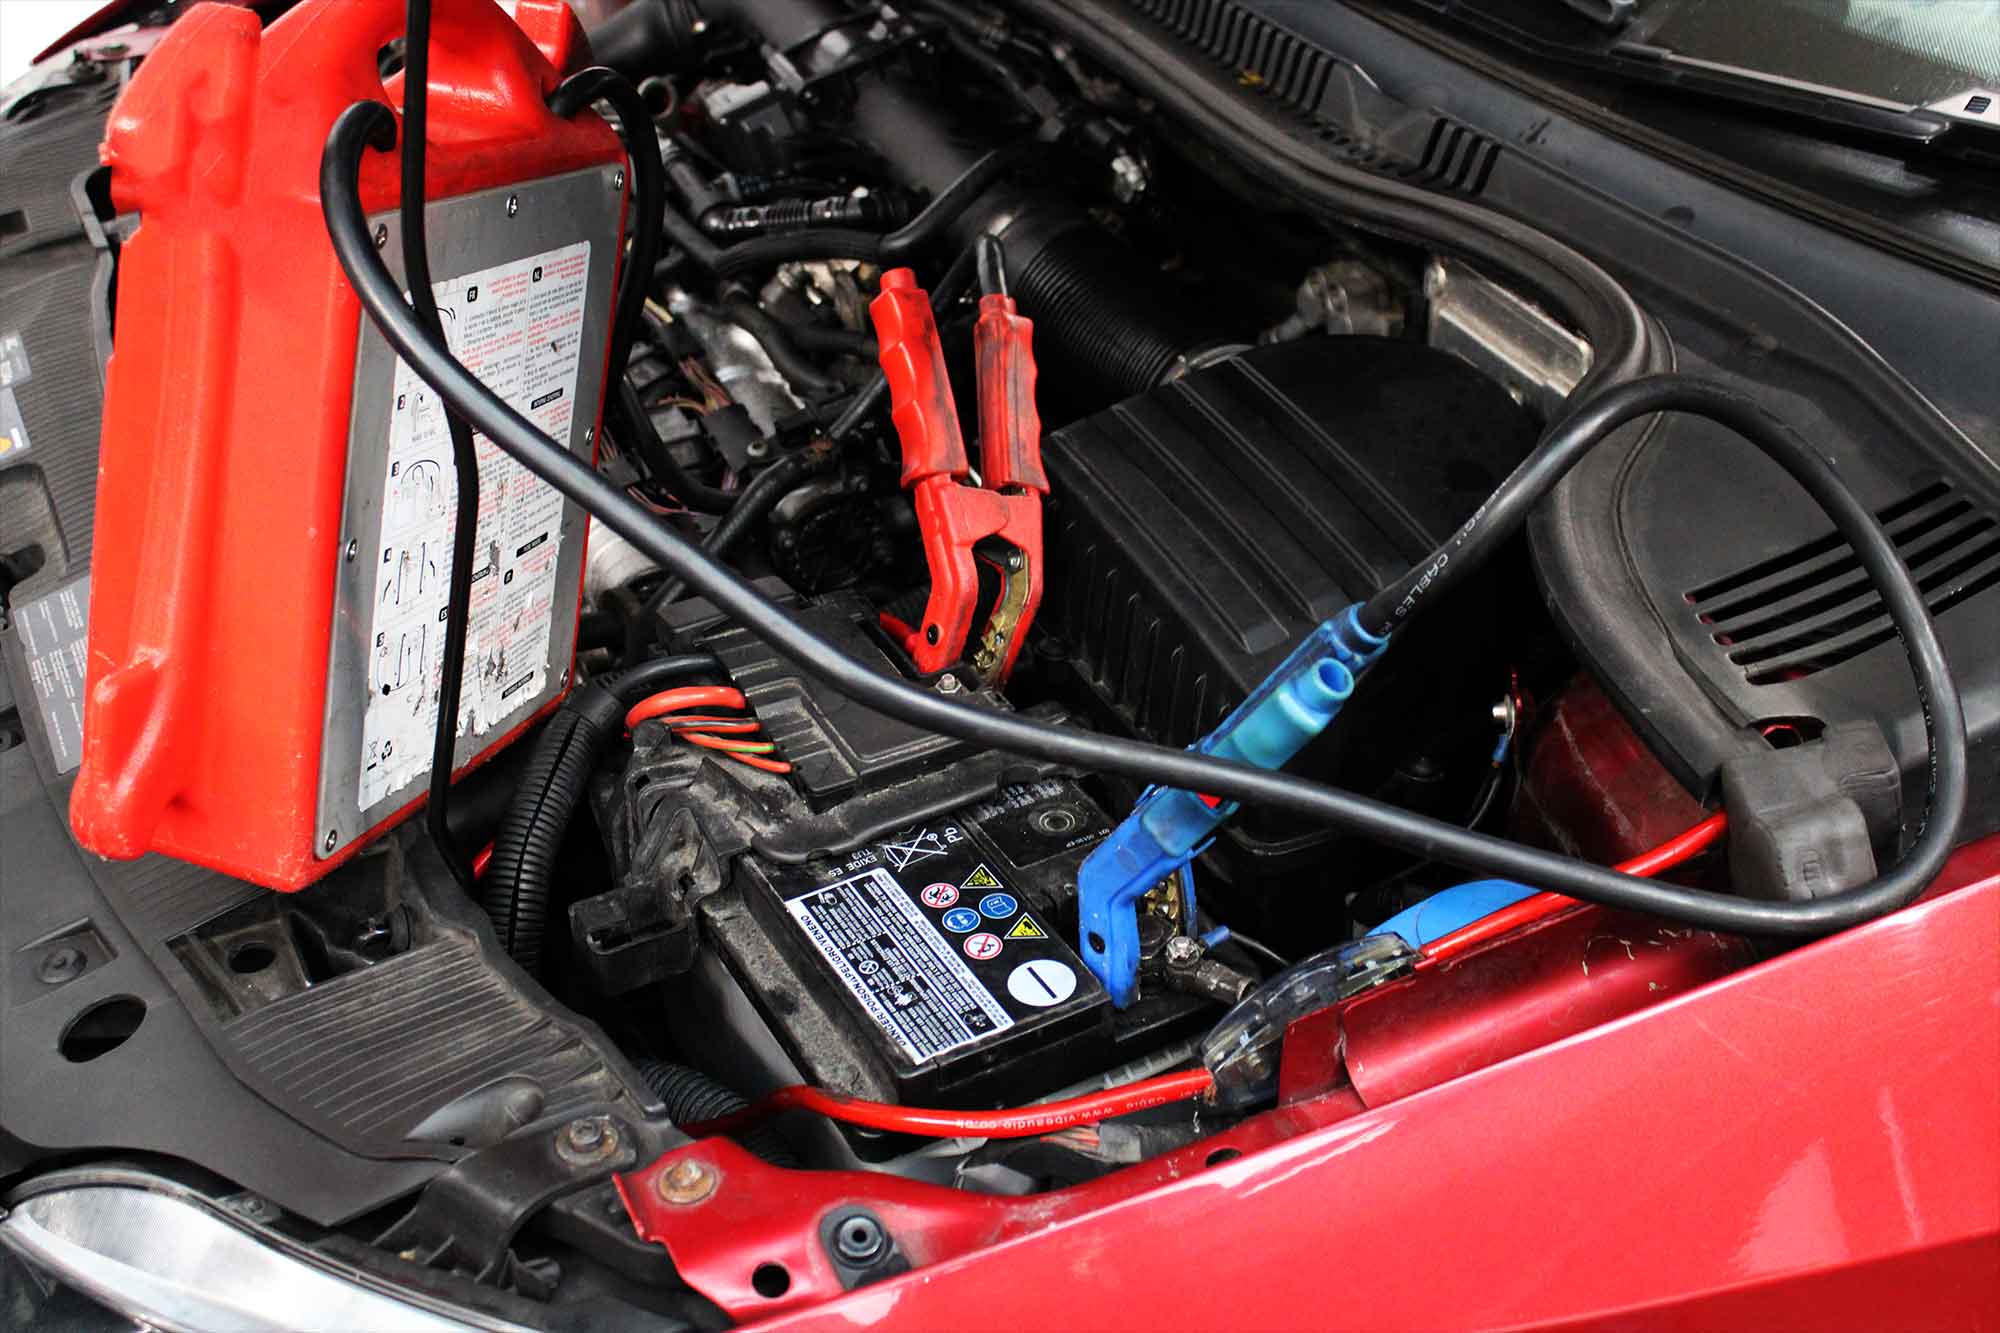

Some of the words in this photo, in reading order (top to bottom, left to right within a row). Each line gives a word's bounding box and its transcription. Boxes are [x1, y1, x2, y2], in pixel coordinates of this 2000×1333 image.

[1395, 553, 1449, 617] CABLES
[943, 826, 963, 845] Pb
[845, 854, 877, 870] EXIDE
[800, 914, 854, 978] PELIGRO/VENENO
